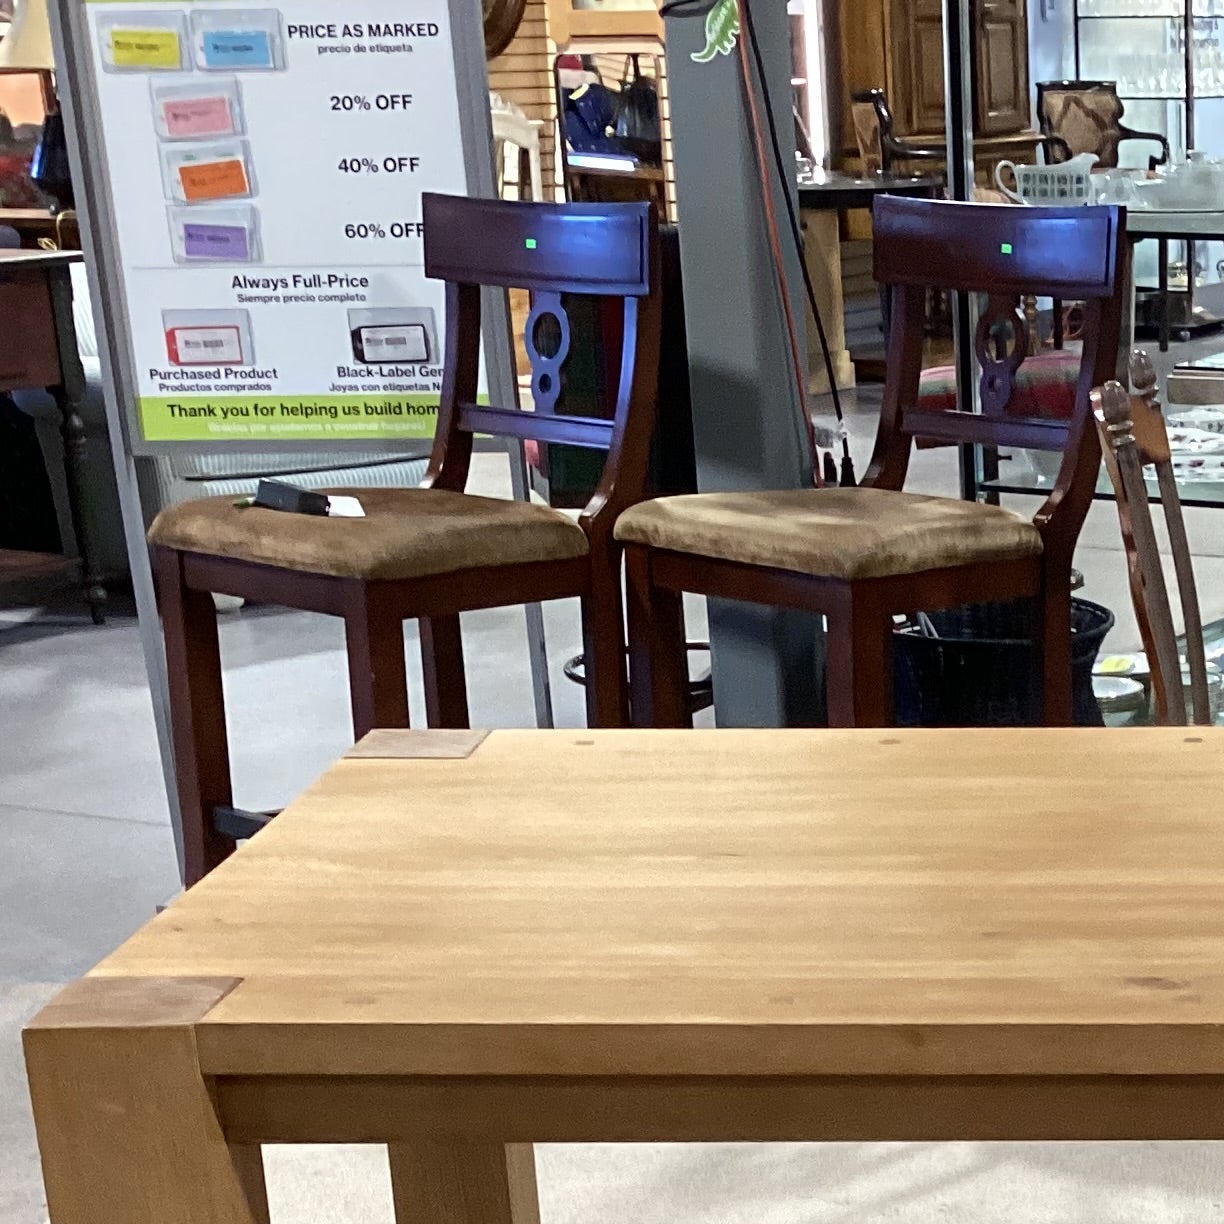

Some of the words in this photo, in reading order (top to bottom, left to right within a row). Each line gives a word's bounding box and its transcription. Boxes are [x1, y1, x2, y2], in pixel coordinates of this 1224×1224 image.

[288, 24, 337, 39] PRICE
[342, 23, 364, 38] AS
[367, 22, 440, 38] MARKED
[317, 45, 350, 55] precio
[352, 44, 367, 54] de
[369, 43, 413, 55] etiqueta
[330, 95, 371, 112] 20%
[375, 94, 413, 110] OFF
[338, 157, 379, 174] 40%
[383, 156, 420, 173] OFF
[345, 223, 386, 240] 60%
[390, 222, 425, 239] OFF
[231, 274, 289, 291] Always
[292, 273, 369, 289] Full-Price
[237, 293, 281, 304] Siempre
[283, 293, 316, 304] precio
[318, 292, 367, 304] completo
[149, 368, 221, 380] Purchased
[224, 366, 278, 380] Product
[337, 365, 416, 379] Black-Label
[158, 382, 212, 393] Productos
[214, 382, 272, 392] comprados
[329, 383, 360, 393] Joyas
[362, 383, 381, 393] con
[383, 382, 431, 393] etiquetas
[167, 404, 217, 417] Thank
[221, 404, 250, 419] you
[254, 403, 277, 417] for
[280, 402, 338, 418] helping
[342, 403, 361, 416] us
[364, 401, 402, 416] build
[406, 401, 440, 416] hom
